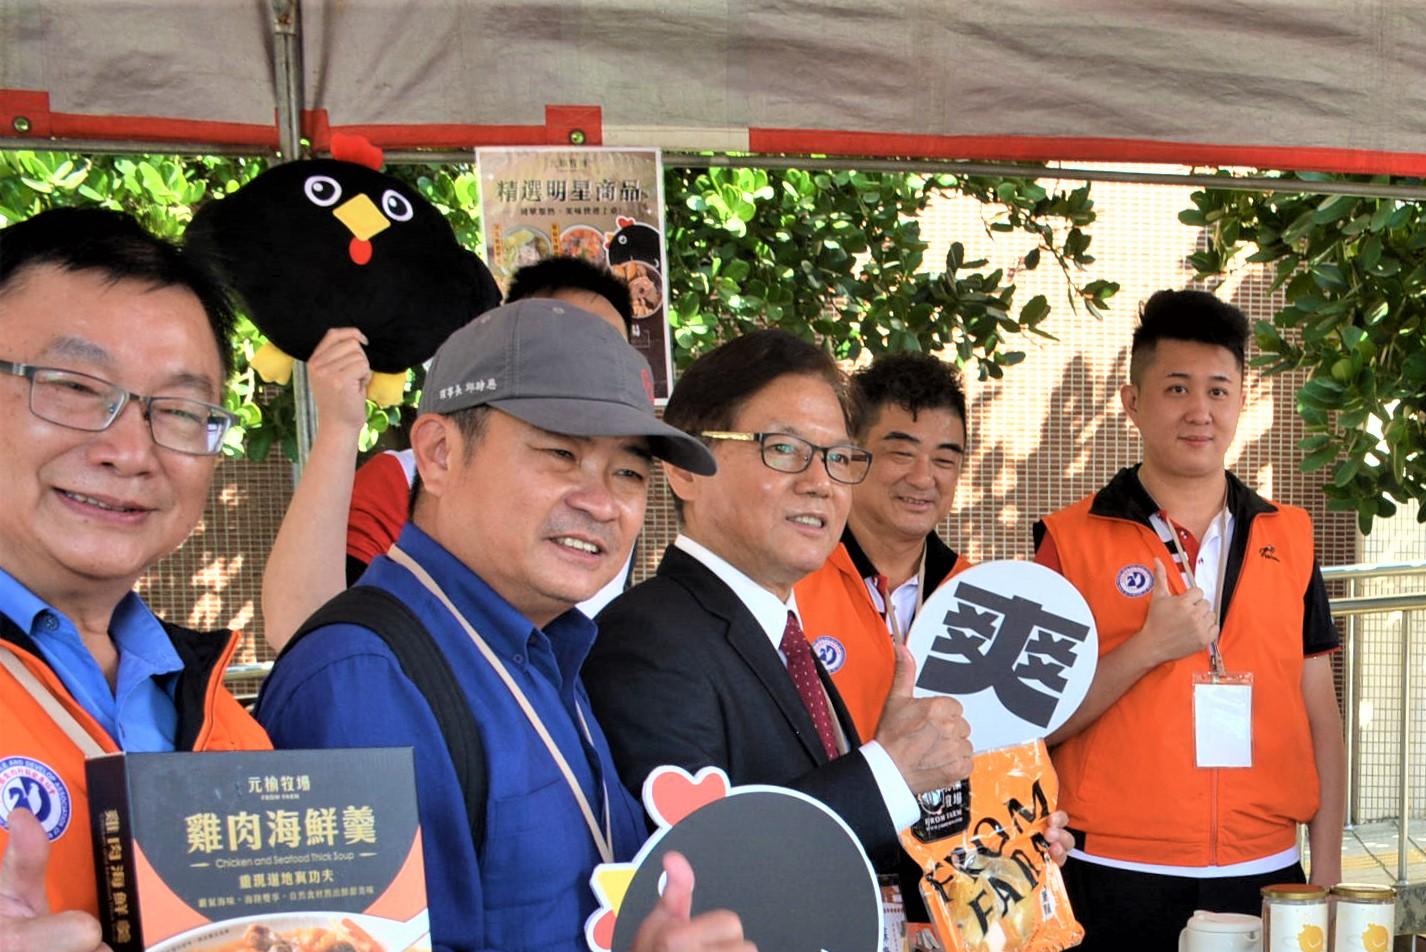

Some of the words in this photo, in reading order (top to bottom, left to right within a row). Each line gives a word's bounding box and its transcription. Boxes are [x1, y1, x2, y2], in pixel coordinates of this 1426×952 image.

[497, 179, 641, 203] 精選明星商品
[916, 581, 1091, 729] 爽
[248, 775, 311, 794] 元榆牧場
[184, 805, 377, 854] 雞肉海鮮羹
[216, 857, 252, 869] Chicken
[254, 856, 271, 866] and
[273, 854, 310, 865] Seafood
[334, 851, 354, 863] Soup
